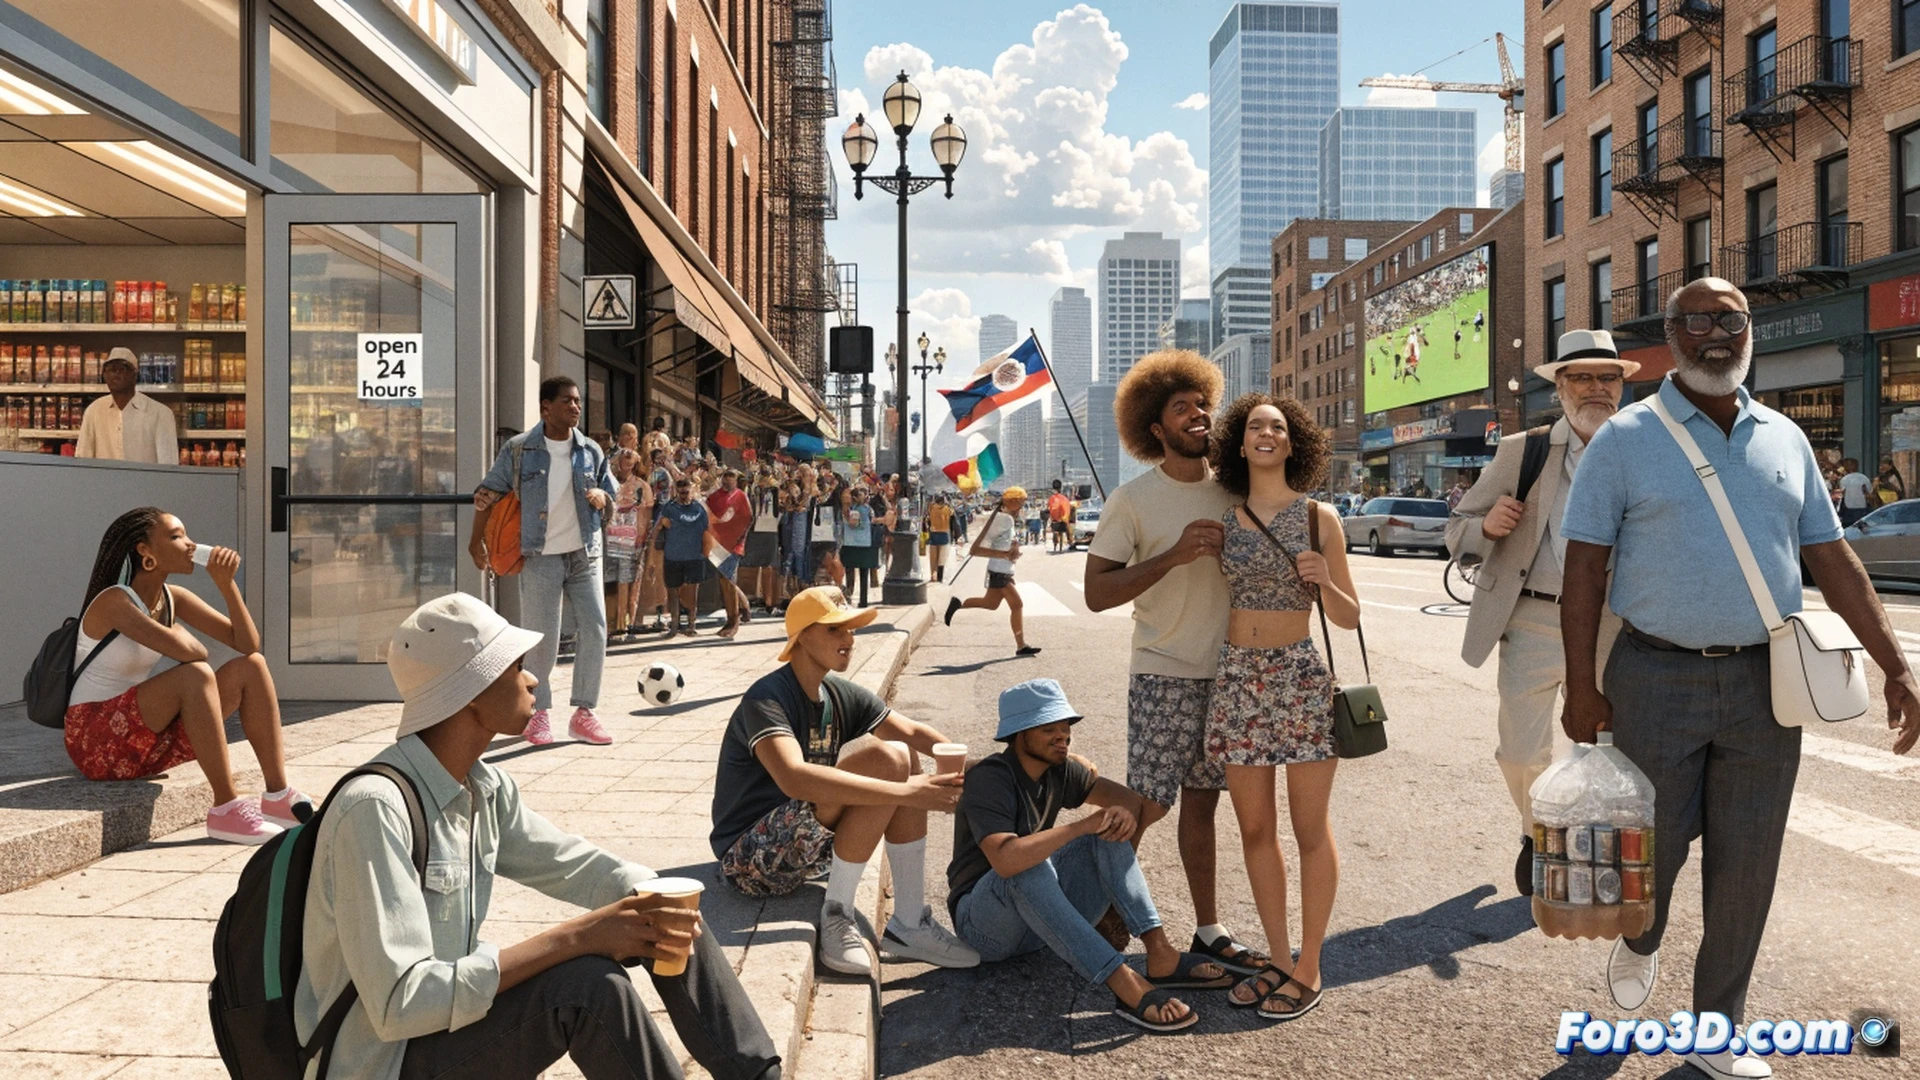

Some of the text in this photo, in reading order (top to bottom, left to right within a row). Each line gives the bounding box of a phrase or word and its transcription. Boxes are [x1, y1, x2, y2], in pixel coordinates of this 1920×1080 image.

[364, 340, 417, 359] open
[377, 359, 406, 379] 24
[362, 380, 417, 397] hours
